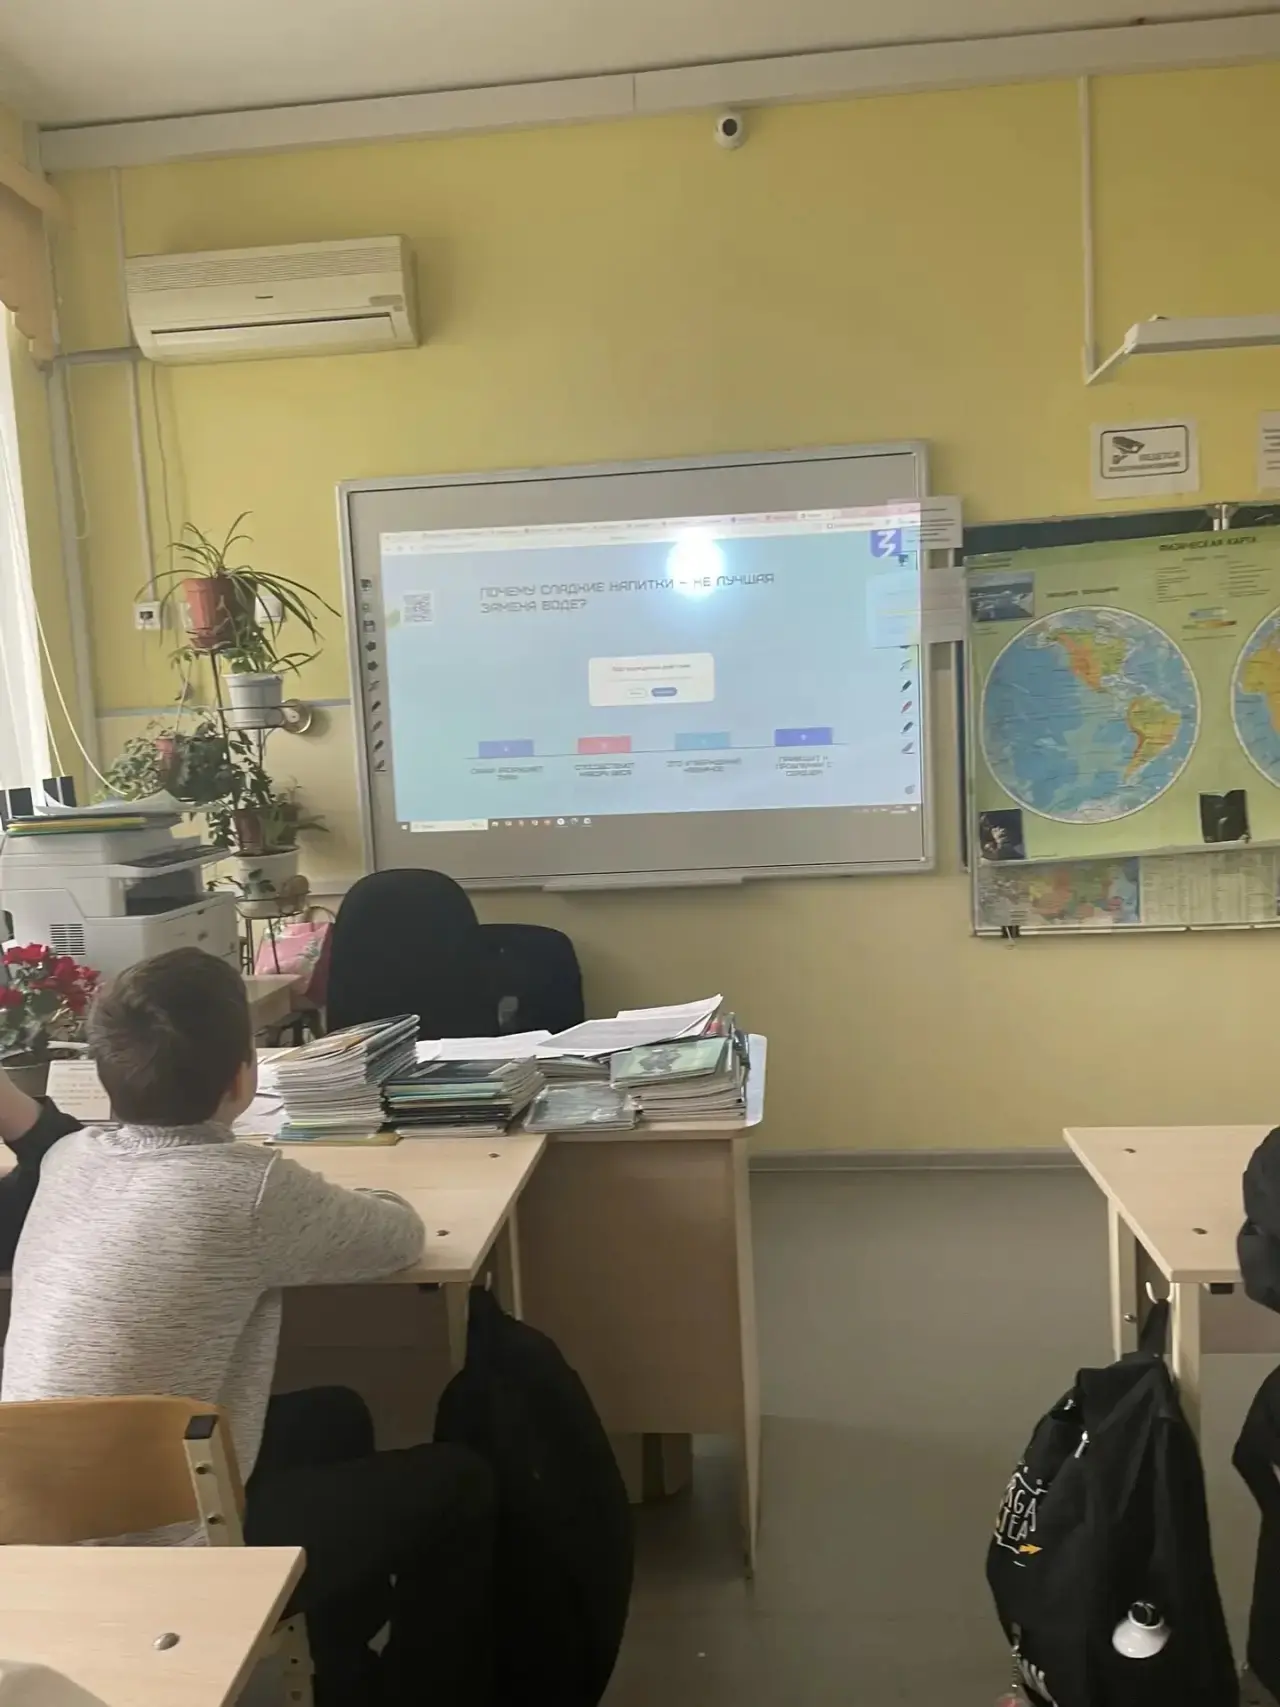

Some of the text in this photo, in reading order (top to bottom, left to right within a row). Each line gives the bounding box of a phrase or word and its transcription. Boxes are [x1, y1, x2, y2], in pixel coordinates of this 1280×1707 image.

[480, 585, 536, 600] ПОЧЕМУ
[540, 581, 605, 596] СЛАДКИЕ
[609, 578, 674, 592] НАПИТКИ
[693, 576, 712, 589] НЕ
[717, 573, 775, 586] ЛУЧШАЯ
[480, 599, 588, 614] ЗАМЕНА ВОДЕ?
